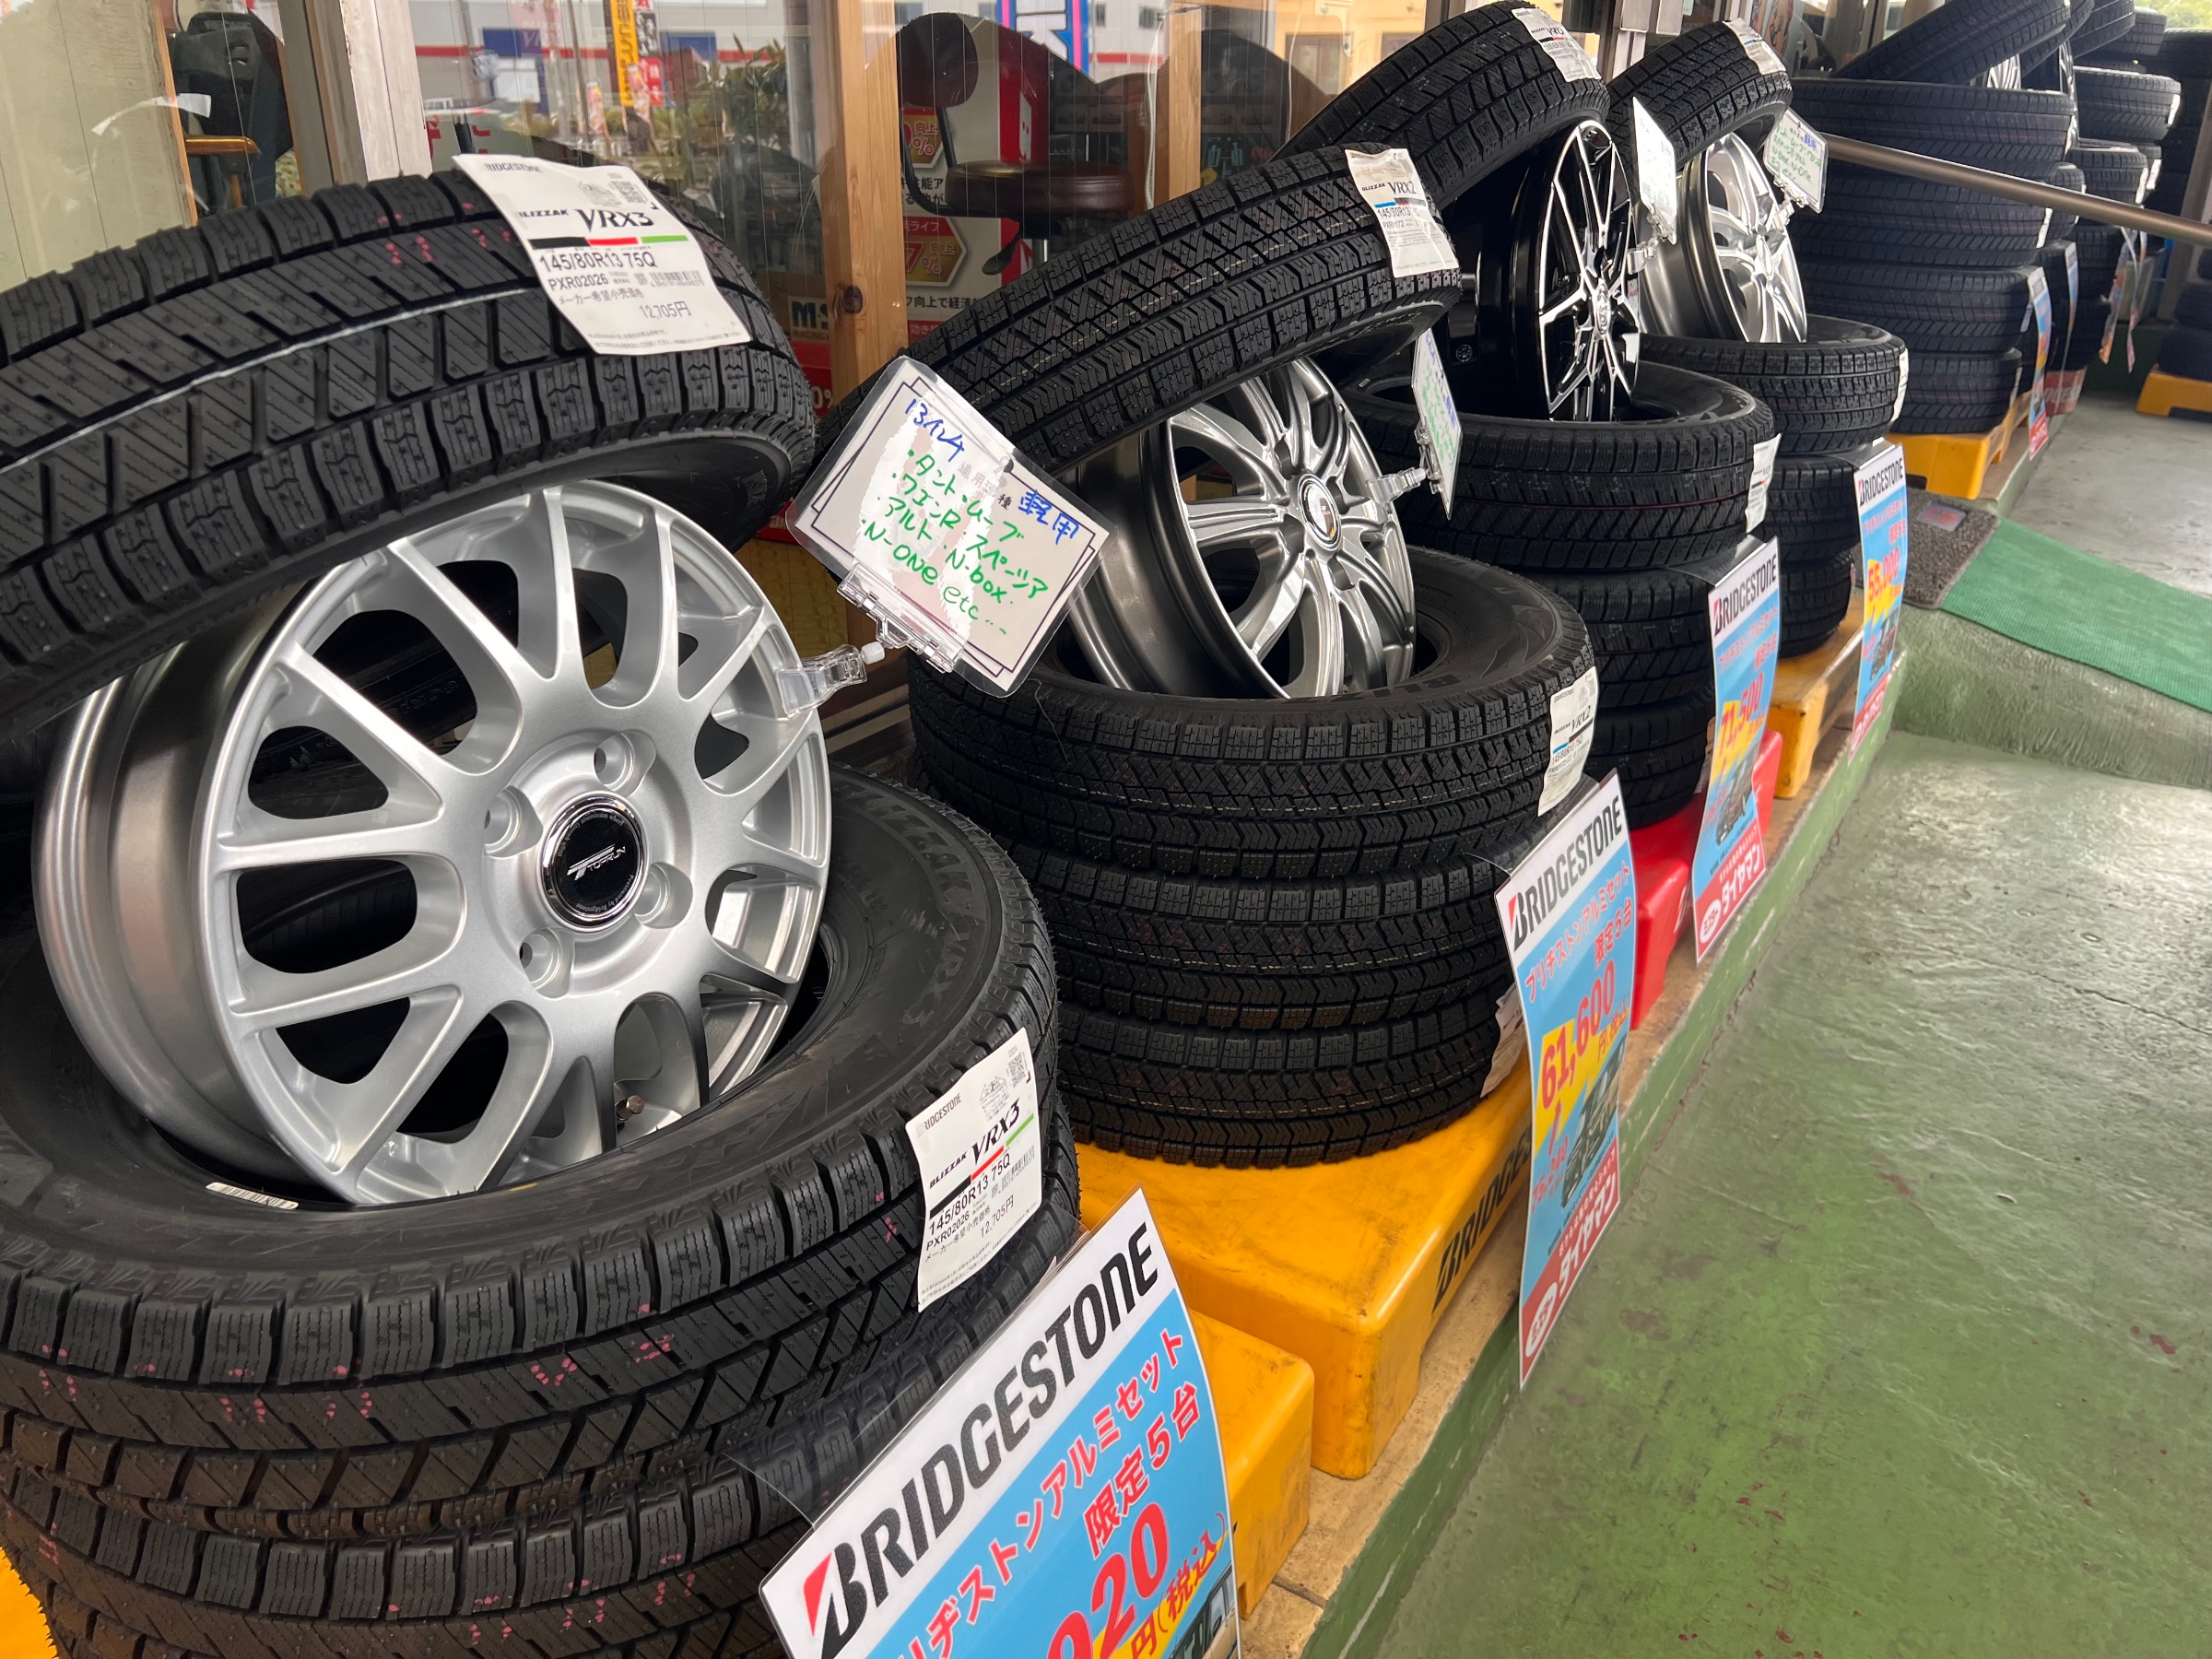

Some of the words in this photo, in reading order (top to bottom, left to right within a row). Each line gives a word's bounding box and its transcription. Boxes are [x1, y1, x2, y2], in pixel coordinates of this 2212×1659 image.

[915, 122, 938, 134] 向上
[482, 162, 542, 173] RIDGESTONE
[1387, 182, 1417, 195] VRX2
[575, 208, 655, 232] VRX3
[539, 251, 622, 273] 145/80R13
[624, 251, 658, 269] 75Q
[930, 242, 955, 254] 向上
[548, 273, 608, 292] PXR02026
[559, 288, 644, 306] メーカー希望小売価格
[640, 302, 691, 319] 12,705円
[1858, 458, 1903, 507] BRIDGESTONE
[1867, 546, 1900, 603] 55,000
[1713, 554, 1777, 638] BRIDGESTONE
[1571, 705, 1591, 732] VRX2
[1508, 794, 1622, 952] BRIDGESTONE
[1524, 859, 1630, 1003] ブリヂストンアルミセット
[1541, 960, 1616, 1110] 61,600
[920, 1092, 962, 1132] RIDGESTONE
[929, 1151, 967, 1189] BLIZZAK
[971, 1098, 1020, 1165] VRX3
[929, 1176, 989, 1236] 145/80R13
[992, 1152, 1011, 1181] 75Q
[924, 1205, 991, 1262] メーカー希望小売価格
[926, 1212, 970, 1252] PXR02026
[980, 1194, 1015, 1238] 12,705円
[1558, 1171, 1618, 1294] タイヤマン
[802, 1222, 1159, 1659] BRIDGESTONE
